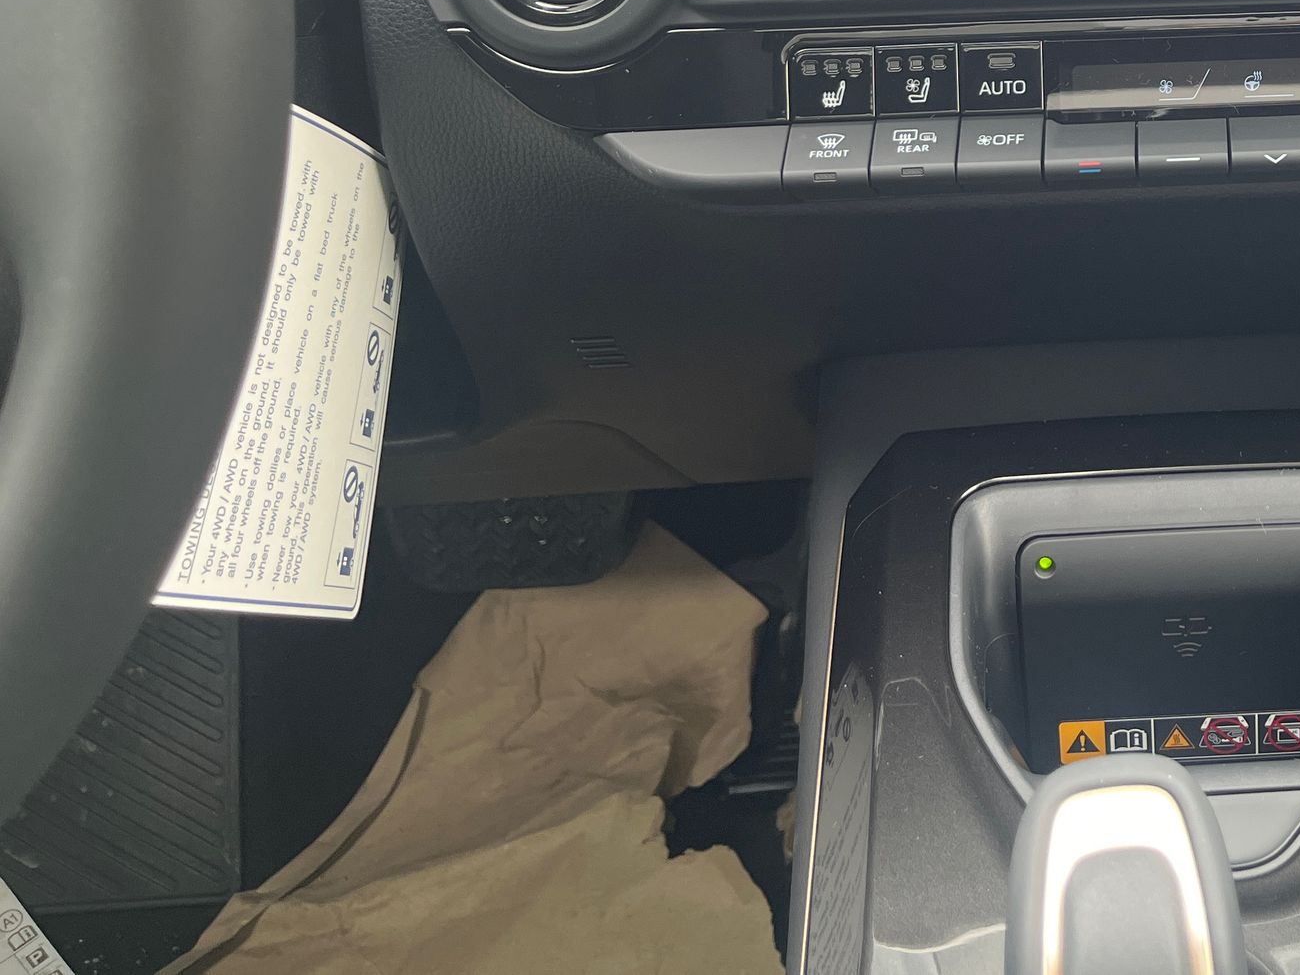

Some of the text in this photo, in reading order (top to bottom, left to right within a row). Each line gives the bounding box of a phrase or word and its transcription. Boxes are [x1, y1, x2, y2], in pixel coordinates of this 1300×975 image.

[978, 80, 1026, 95] AUTO
[809, 149, 850, 159] FRONT
[897, 144, 929, 153] REAR
[992, 134, 1024, 145] OFF
[202, 544, 216, 575] Your
[212, 507, 226, 540] 4WD
[224, 459, 238, 493] AWD
[236, 402, 253, 450] vehicle
[248, 384, 257, 394] is
[255, 353, 265, 375] not
[262, 284, 282, 346] designed
[279, 264, 287, 276] to
[283, 240, 293, 256] be
[302, 160, 312, 185] with
[216, 170, 319, 576] any wheels on the ground. It should only be towed with
[245, 553, 257, 579] Use
[253, 499, 271, 544] towing
[267, 448, 282, 491] dollies
[280, 425, 287, 439] or
[284, 382, 296, 417] place
[294, 329, 308, 374] vehicle
[307, 305, 314, 321] on
[314, 263, 323, 281] flat
[320, 231, 330, 255] bed
[327, 193, 337, 223] truck
[228, 378, 282, 577] all four wheels off the ground.
[178, 507, 206, 582] TOWING
